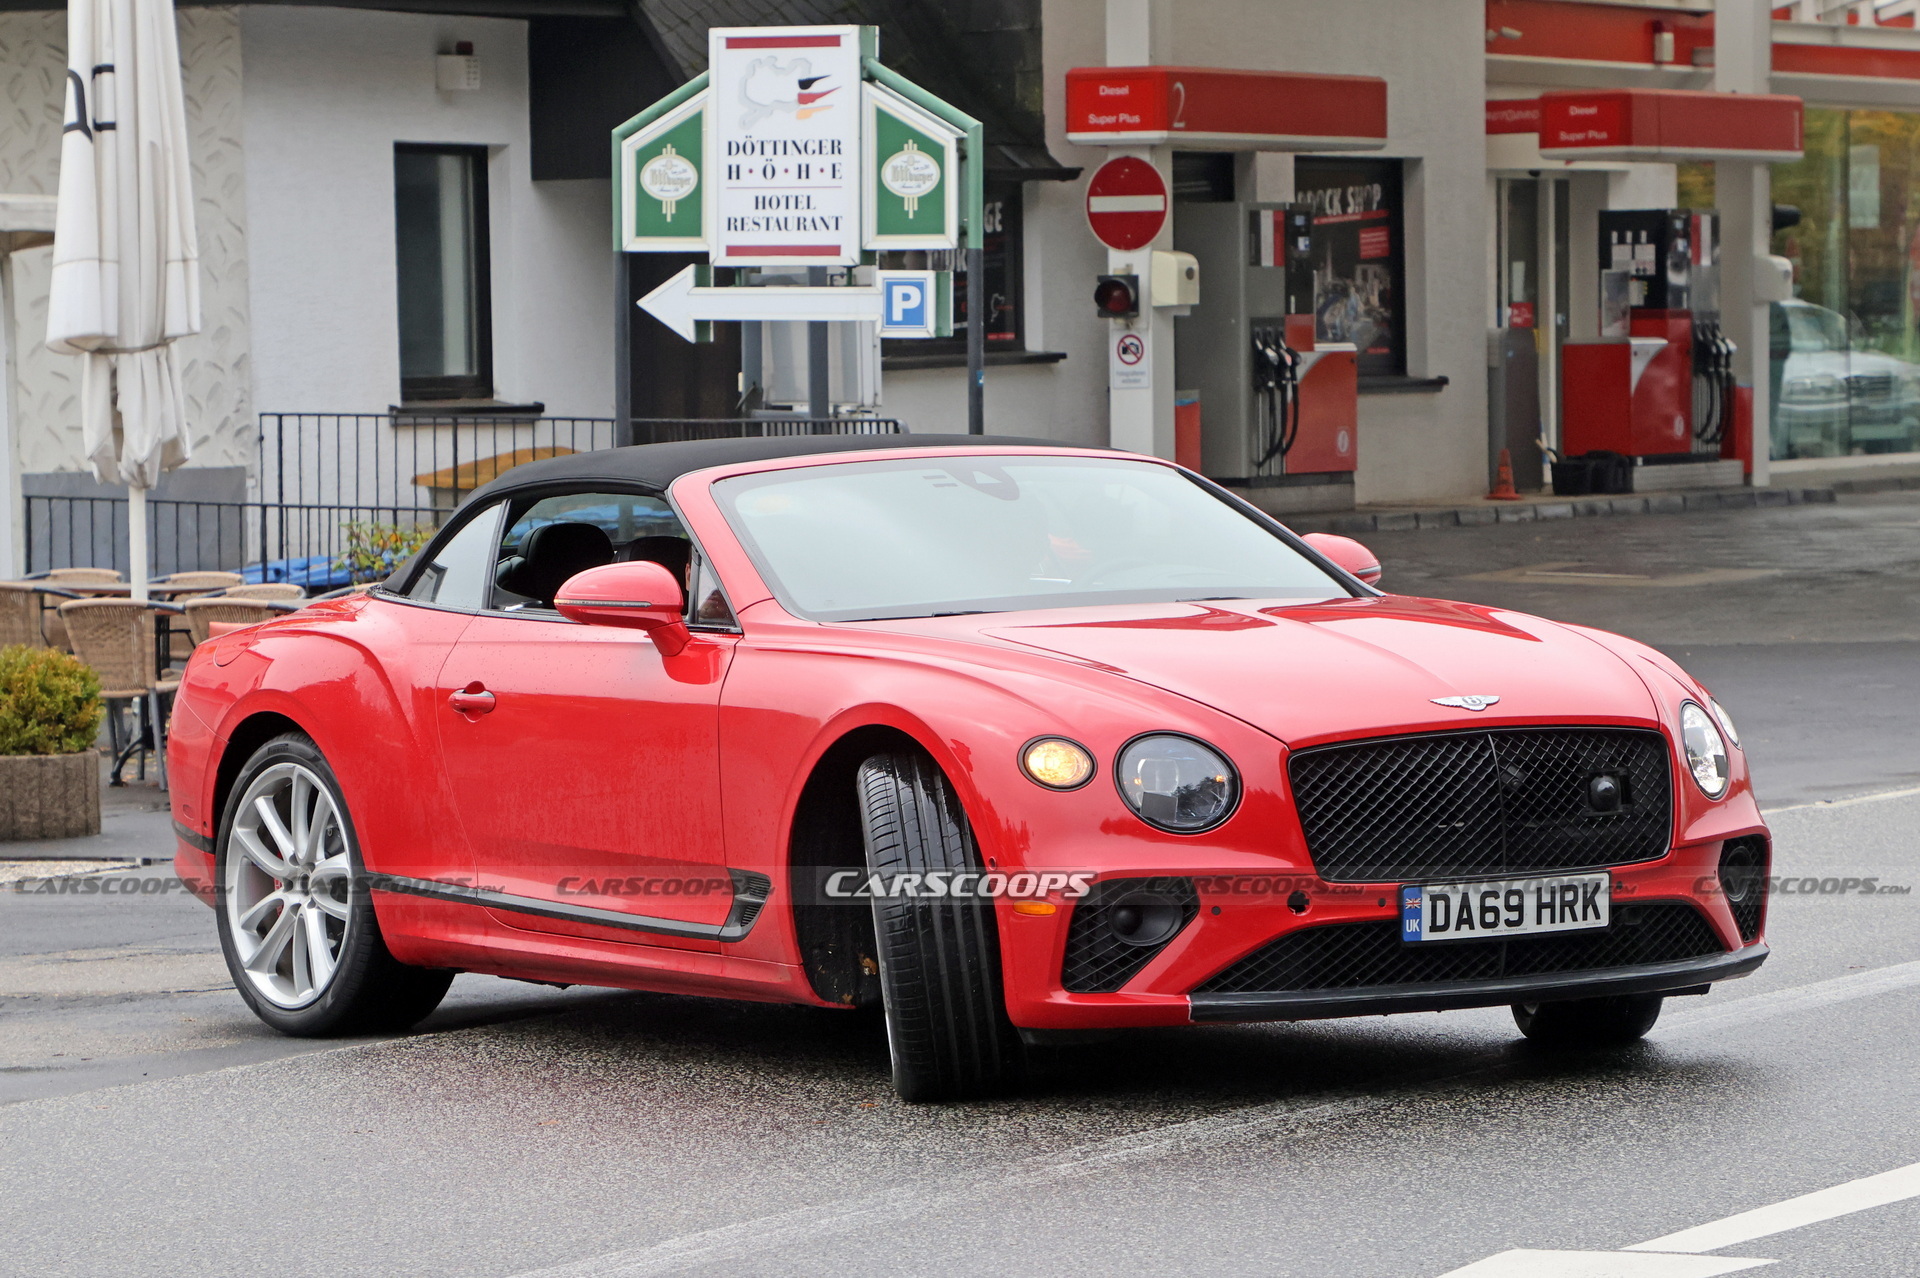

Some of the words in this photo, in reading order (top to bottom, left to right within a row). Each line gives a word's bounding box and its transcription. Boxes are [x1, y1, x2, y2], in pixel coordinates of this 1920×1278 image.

[1099, 85, 1130, 96] Diesel
[1172, 81, 1186, 128] 2
[1088, 113, 1117, 125] Super
[1118, 113, 1141, 124] Plus
[727, 136, 842, 157] DÖTTINGER
[754, 195, 817, 211] HOTEL
[726, 215, 843, 232] RESTAURANT
[892, 285, 922, 321] P
[1429, 889, 1525, 933] DA69
[1536, 882, 1601, 926] HRK
[1405, 919, 1421, 933] UK
